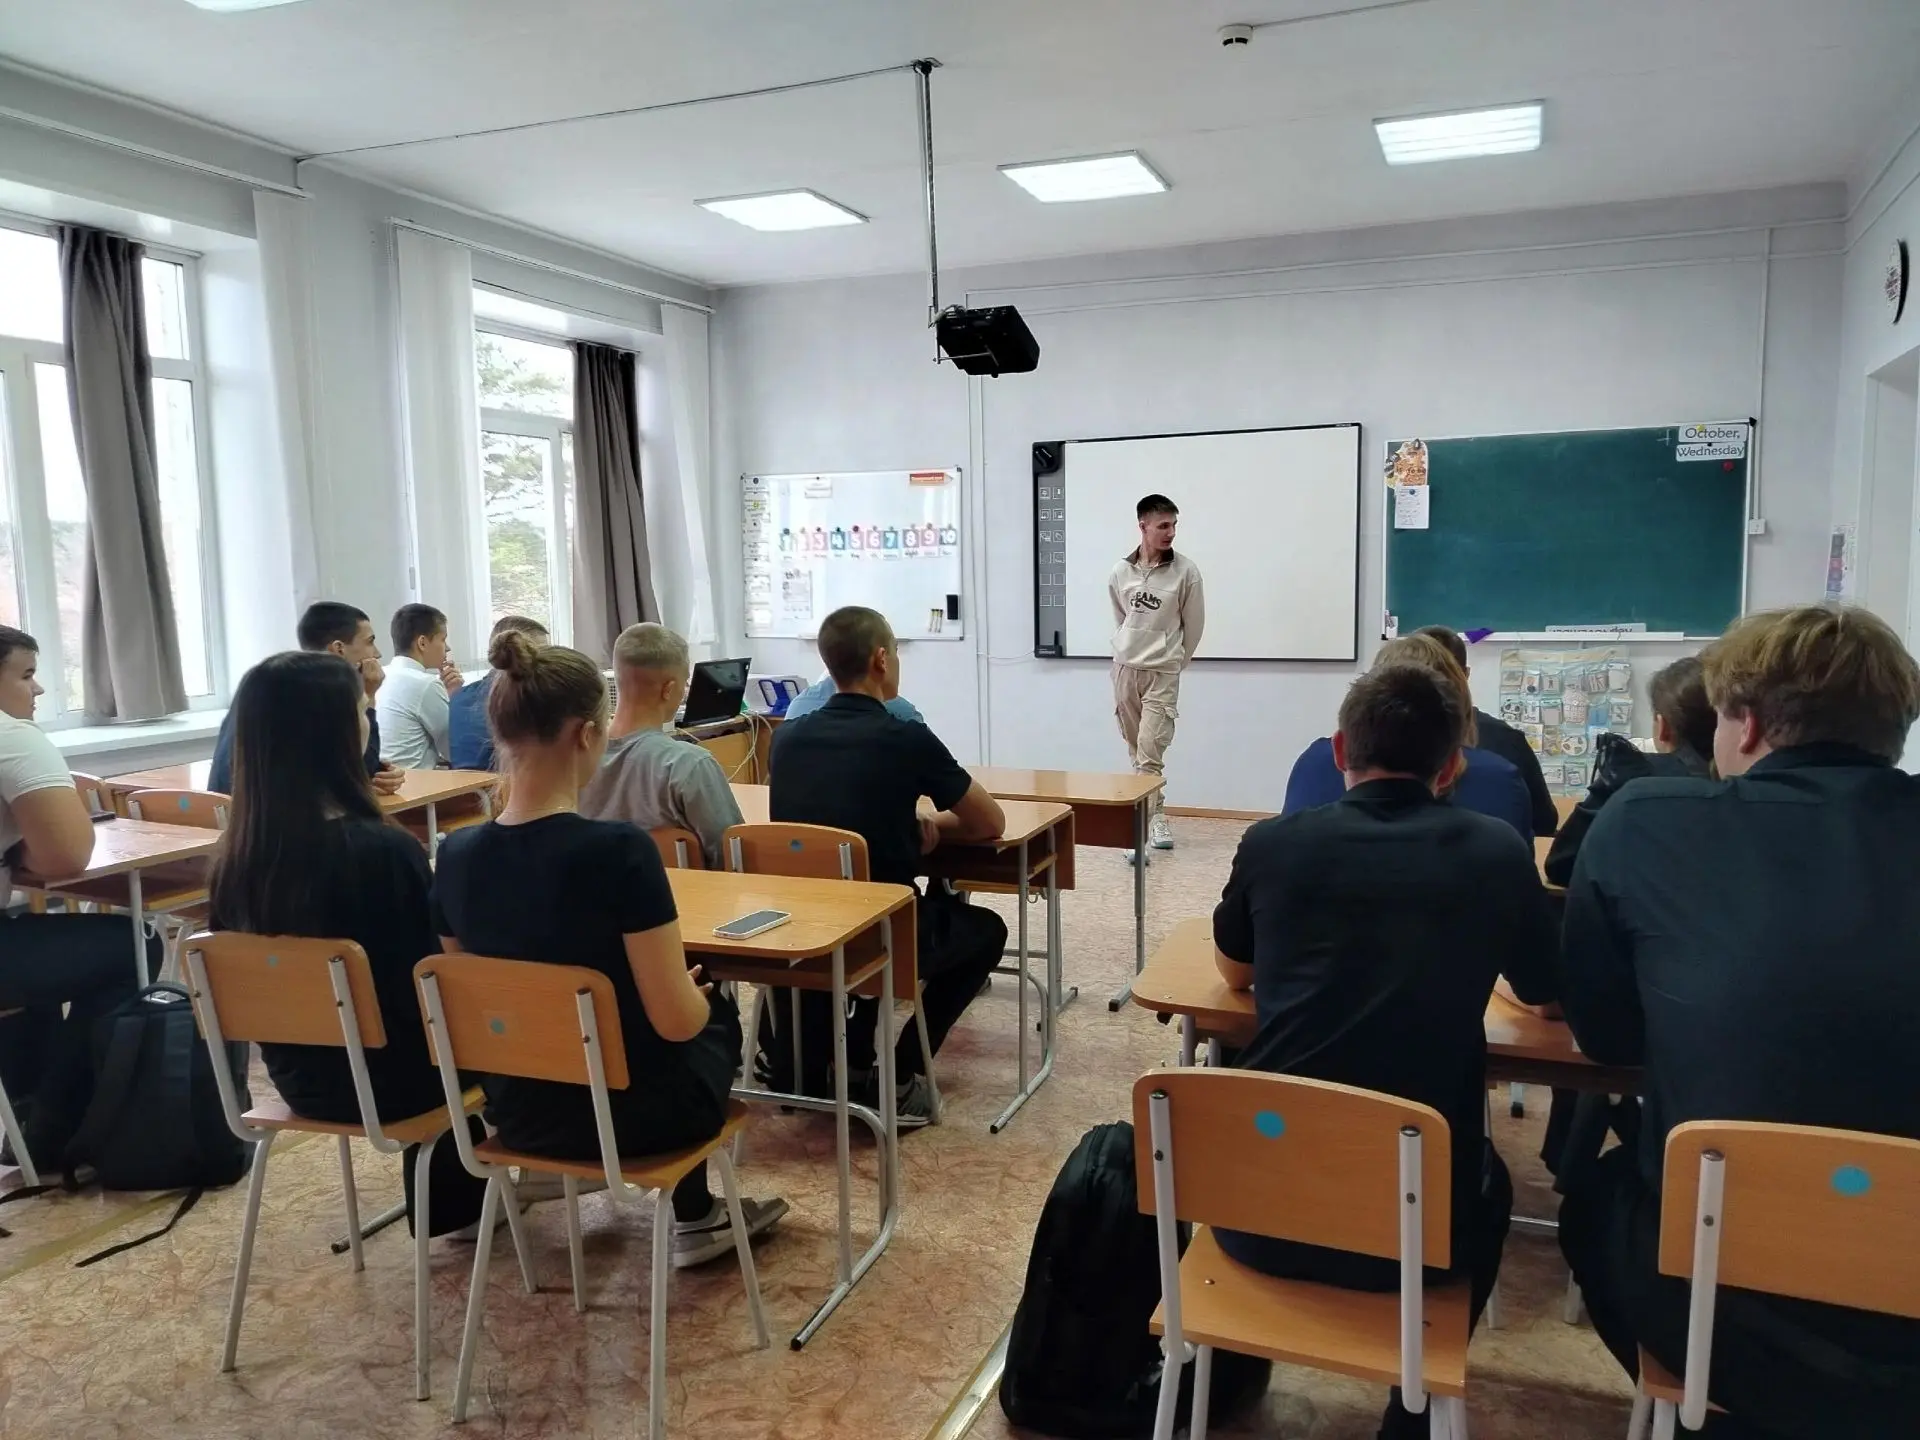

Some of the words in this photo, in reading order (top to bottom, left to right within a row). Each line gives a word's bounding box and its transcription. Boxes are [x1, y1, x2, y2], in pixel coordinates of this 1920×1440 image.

[1685, 427, 1740, 439] October,
[1677, 445, 1745, 457] Wednesday
[832, 534, 843, 549] 4
[851, 534, 860, 547] 5
[870, 533, 880, 547] 6
[886, 533, 895, 547] 7
[905, 532, 916, 546] 8
[924, 531, 934, 545] 9
[941, 531, 956, 544] 10
